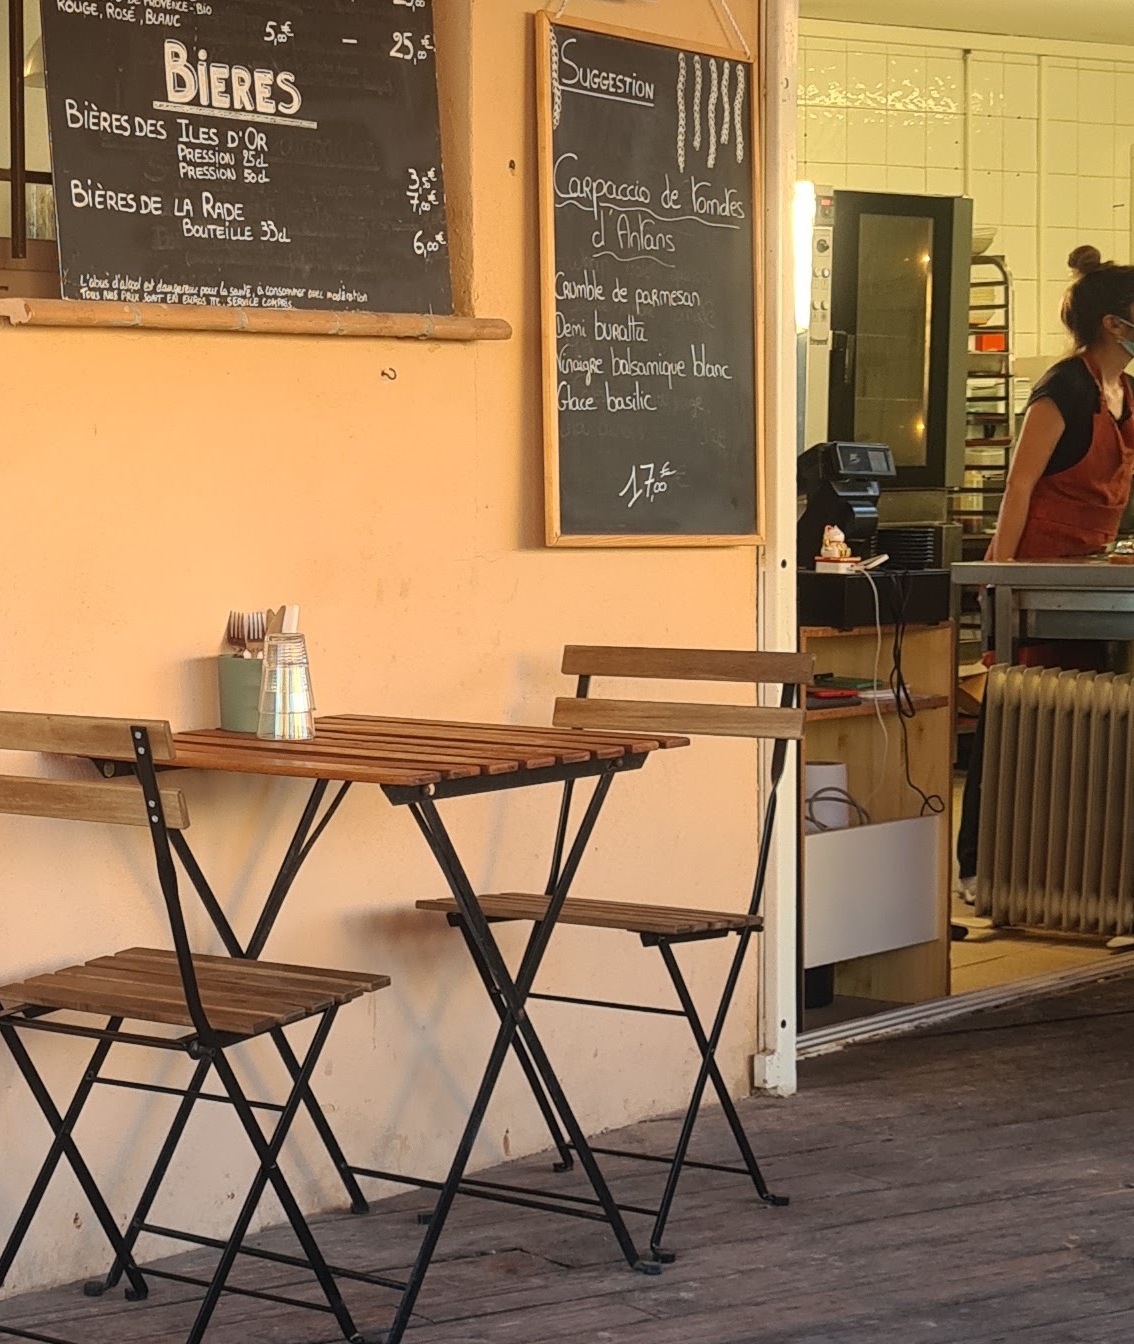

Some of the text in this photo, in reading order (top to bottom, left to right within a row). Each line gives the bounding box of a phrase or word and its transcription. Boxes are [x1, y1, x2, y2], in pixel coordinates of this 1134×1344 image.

[660, 173, 682, 210] de
[611, 277, 628, 303] de
[554, 309, 587, 340] Demi
[609, 342, 733, 390] balsamique blanc
[554, 379, 658, 413] Glace basilic
